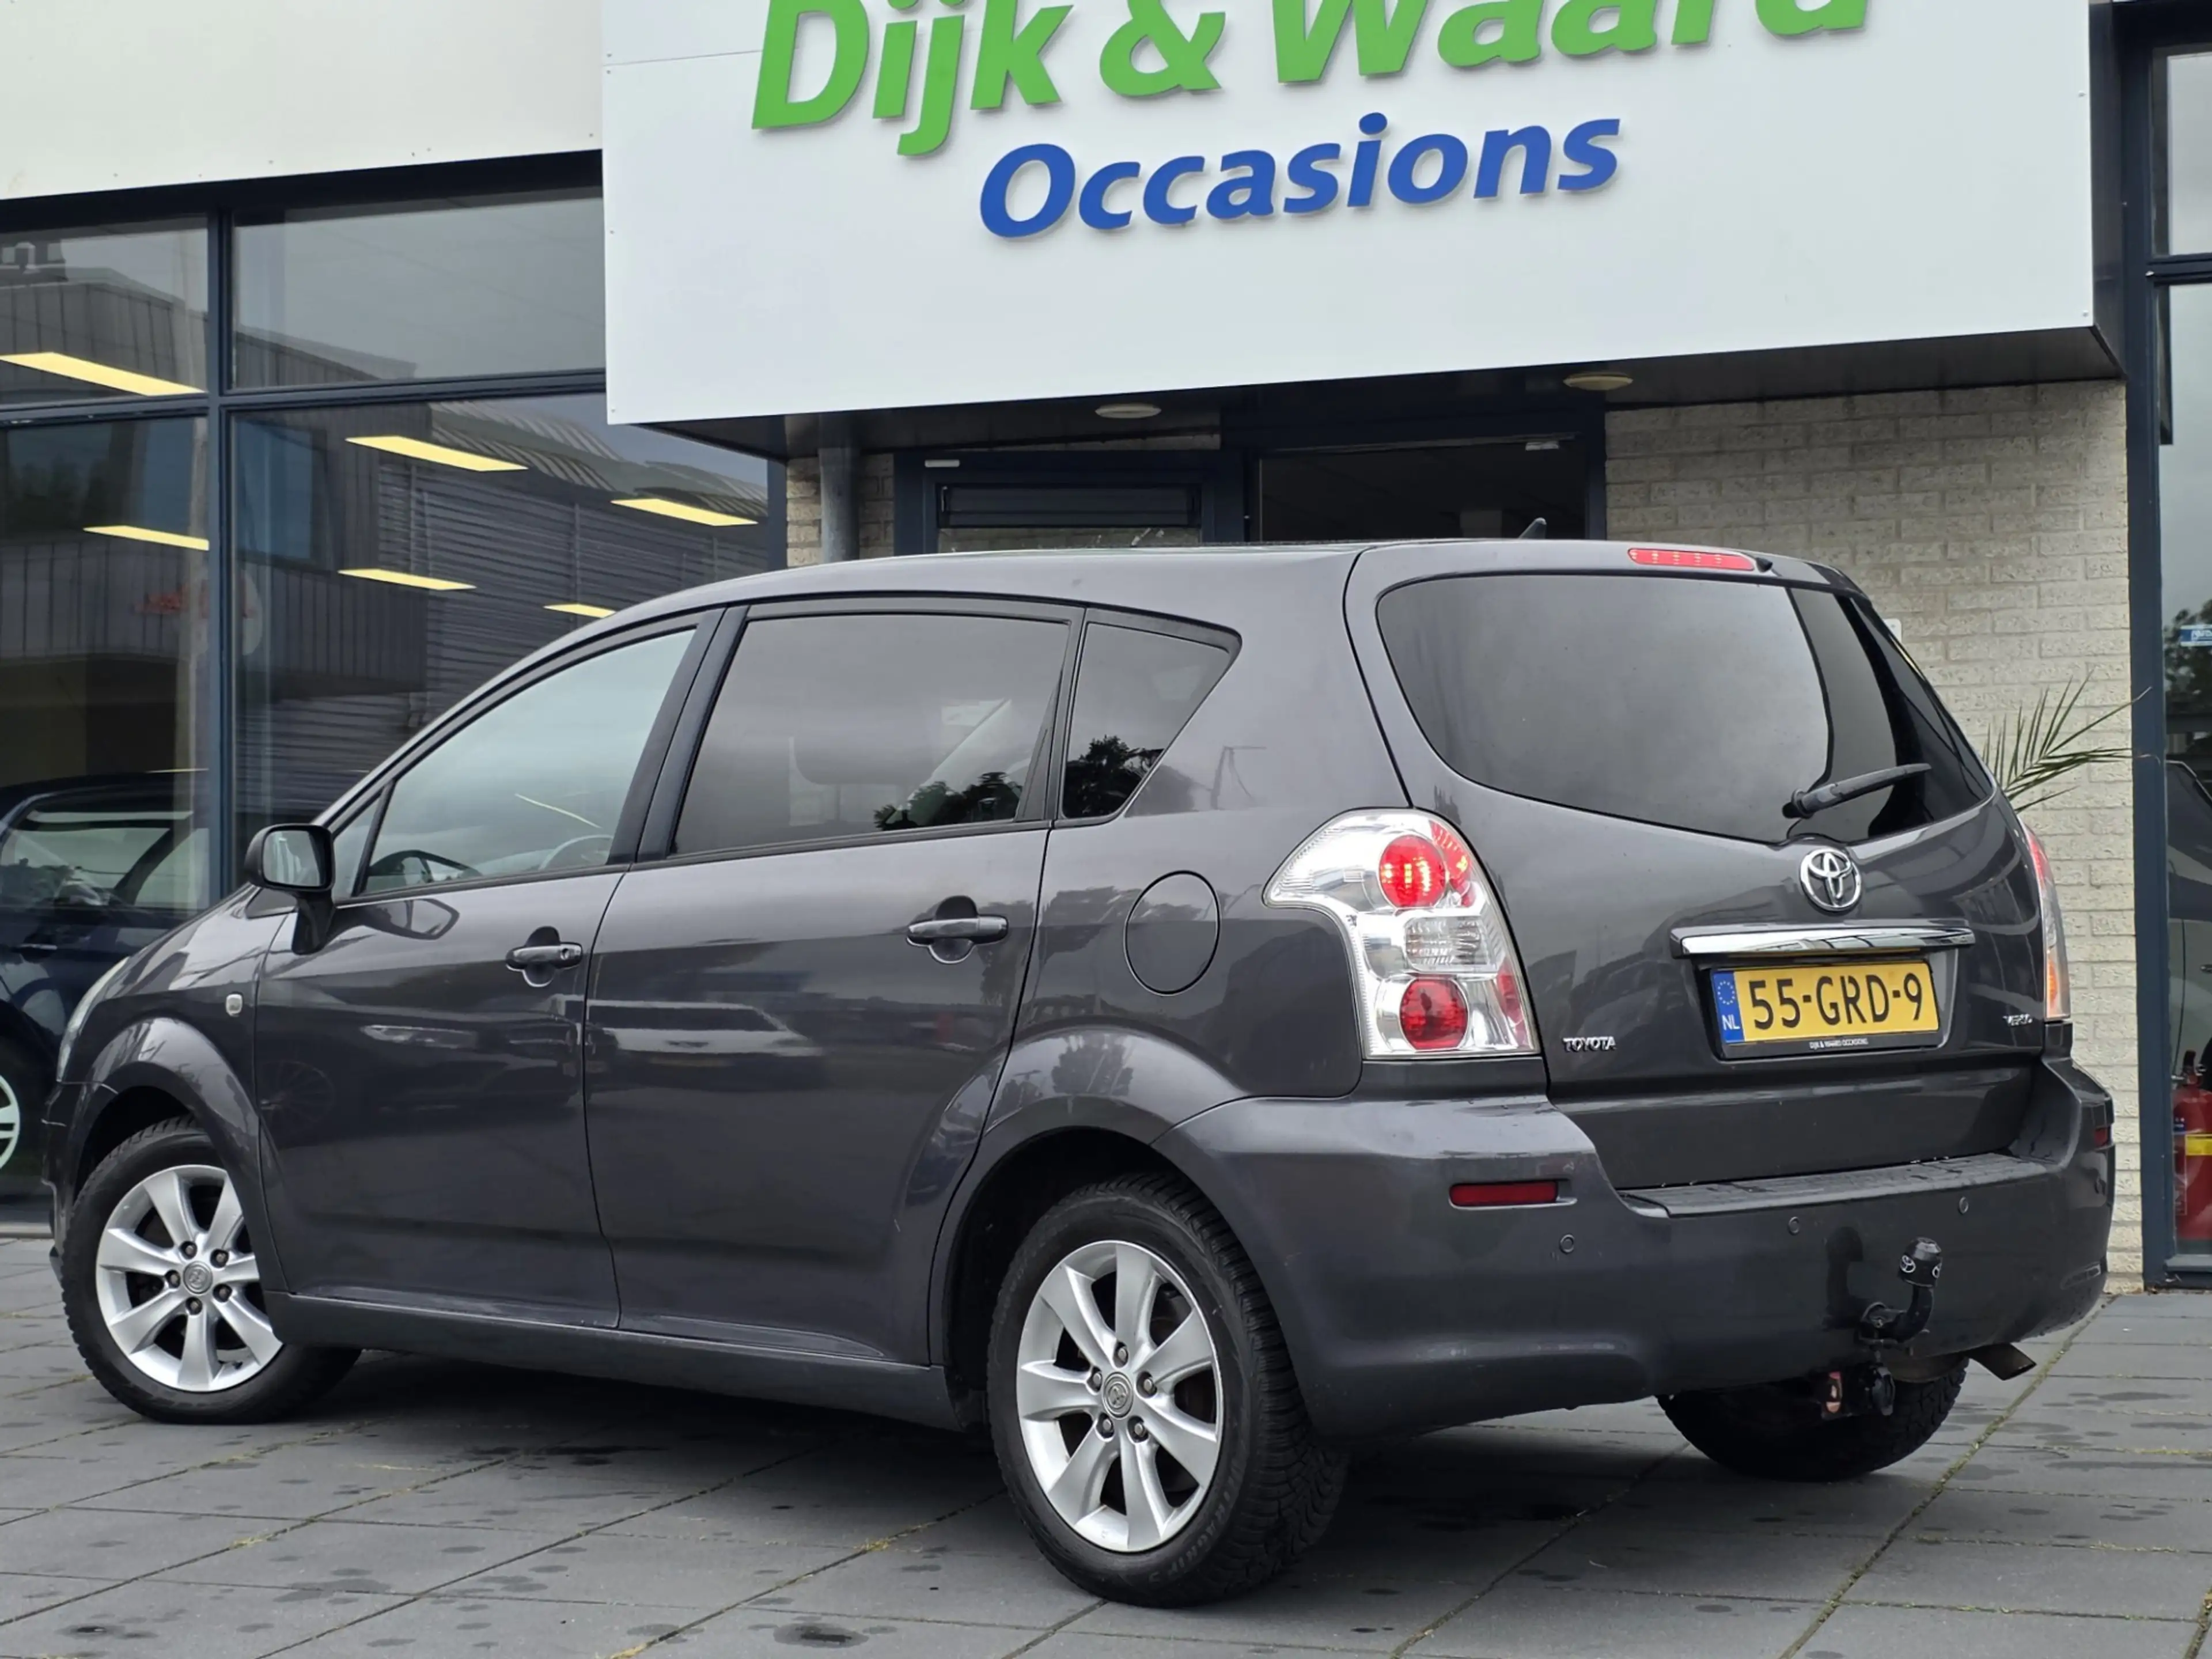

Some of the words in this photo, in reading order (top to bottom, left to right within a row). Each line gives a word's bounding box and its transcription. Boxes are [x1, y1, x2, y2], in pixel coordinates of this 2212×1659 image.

[752, 0, 1071, 156] Dijk
[1100, 0, 1225, 96] &
[1272, 0, 1867, 82] Waa
[980, 113, 1620, 237] Occasions
[1721, 1014, 1741, 1031] NL
[1748, 972, 1922, 1031] 55-GRD-9
[1563, 1036, 1617, 1052] TOYOTA
